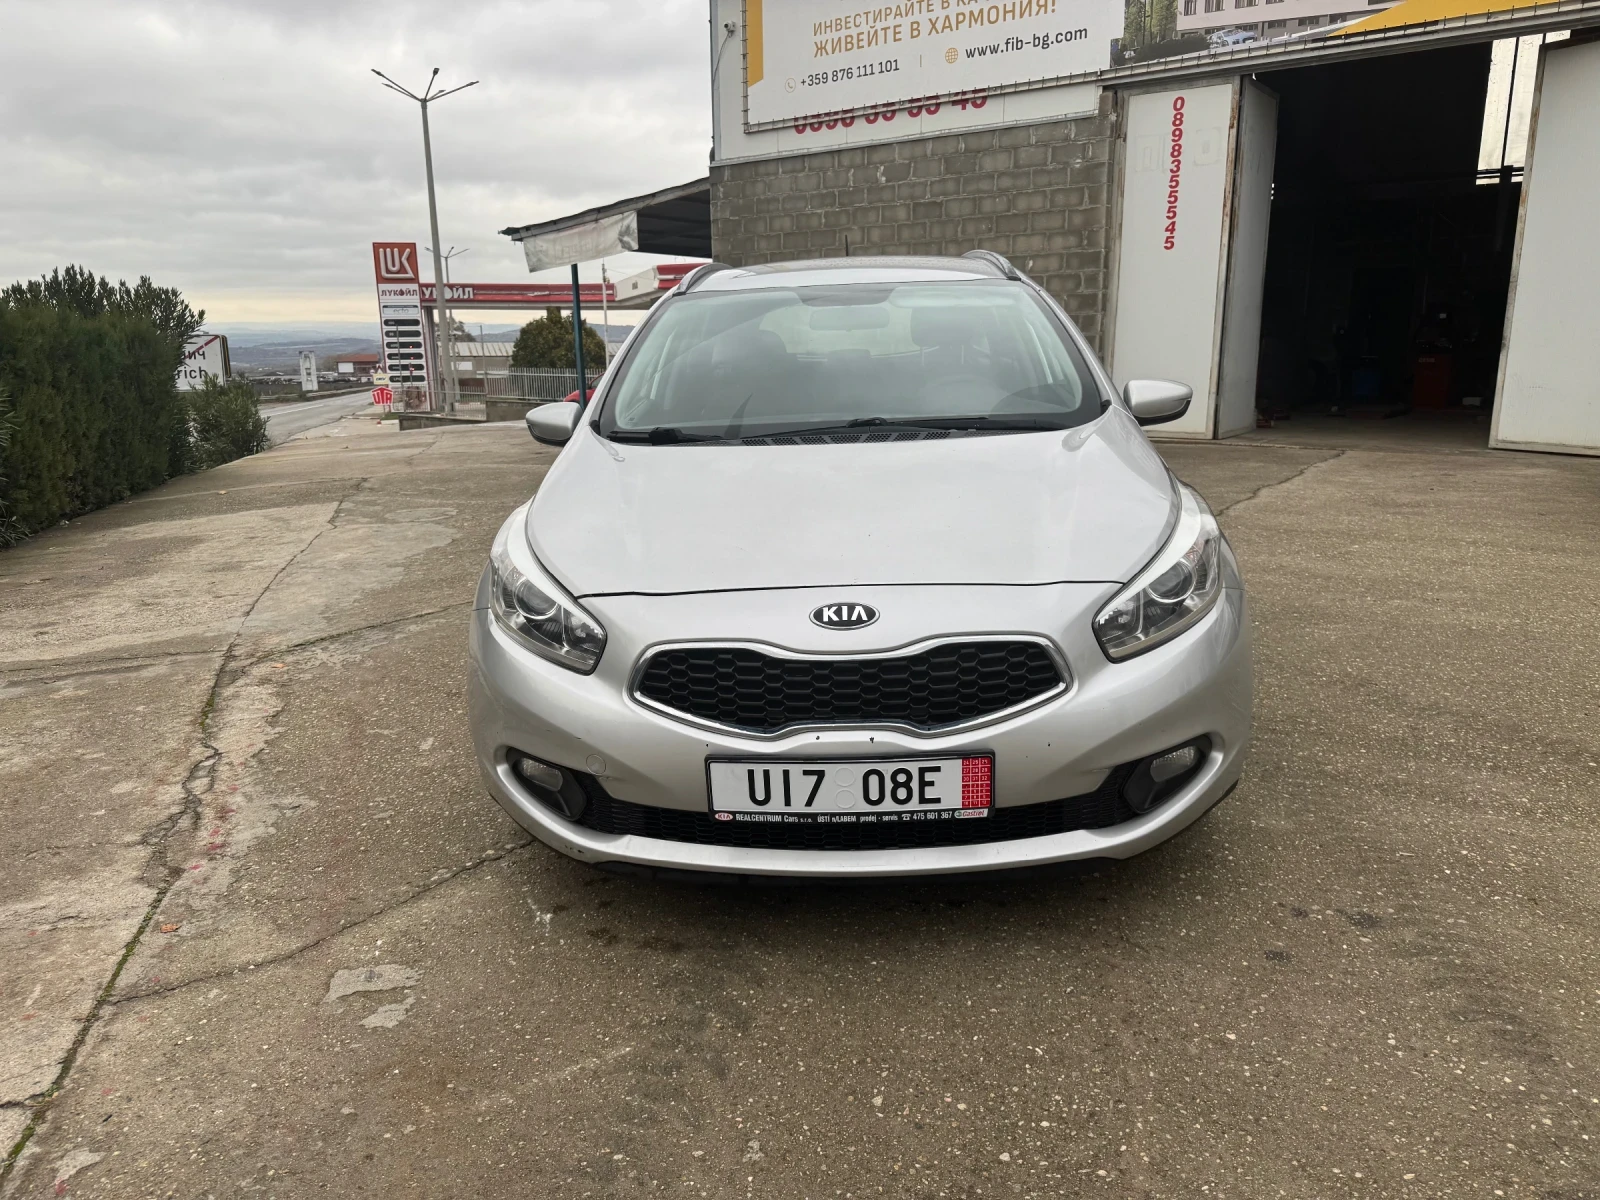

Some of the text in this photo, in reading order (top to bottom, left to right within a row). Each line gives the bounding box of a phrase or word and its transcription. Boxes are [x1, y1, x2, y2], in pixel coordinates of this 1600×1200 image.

[814, 0, 1056, 58] ЖИВЕЙТЕ В ХАРМОНИЯ!
[965, 28, 1088, 59] www.fib-bg.com
[801, 59, 900, 87] +359 876 111 101
[1163, 96, 1186, 250] 0898355545
[822, 605, 869, 622] KIA
[862, 765, 942, 806] 08E
[735, 813, 782, 822] REALCENTRUM
[783, 814, 799, 823] Cars
[860, 814, 877, 823] prodej
[882, 813, 899, 821] servis
[912, 812, 925, 820] 475
[926, 811, 938, 820] 601
[940, 811, 952, 819] 367
